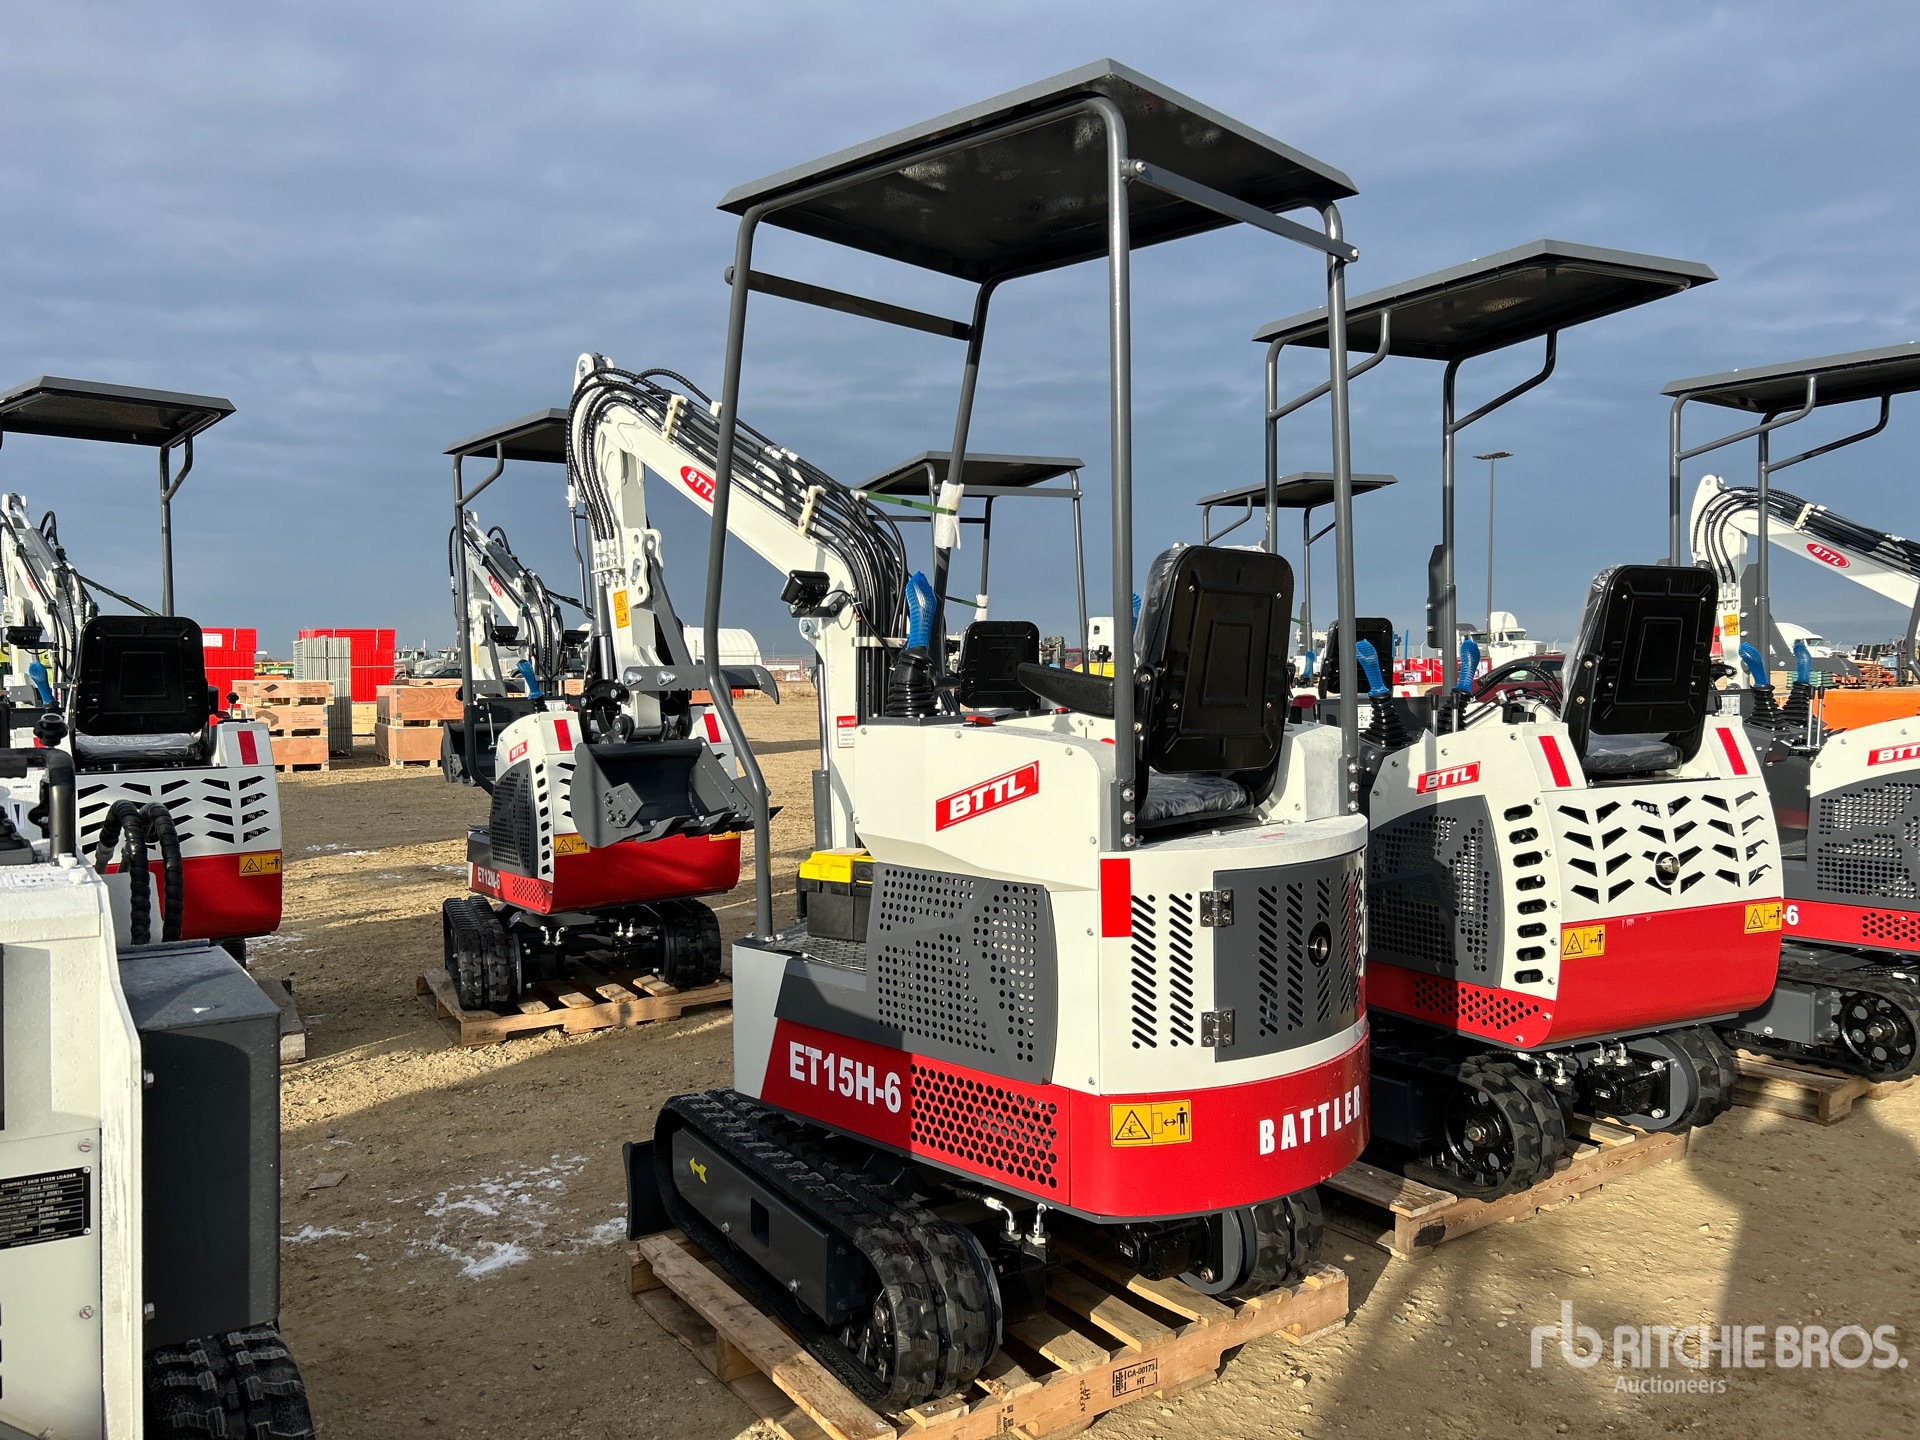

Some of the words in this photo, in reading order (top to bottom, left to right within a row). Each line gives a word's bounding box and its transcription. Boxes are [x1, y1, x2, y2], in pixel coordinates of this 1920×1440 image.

[1812, 546, 1840, 565] BTTL
[511, 744, 526, 760] BTTL
[1877, 745, 1920, 762] BTT
[1425, 768, 1472, 789] BTTL
[949, 774, 1027, 820] BTTL
[788, 1040, 902, 1114] ET15H-6
[1259, 1084, 1361, 1156] BATTLER
[1, 1180, 27, 1188] COMPACT
[1127, 1364, 1155, 1378] CA-00173
[1136, 1376, 1146, 1386] HT
